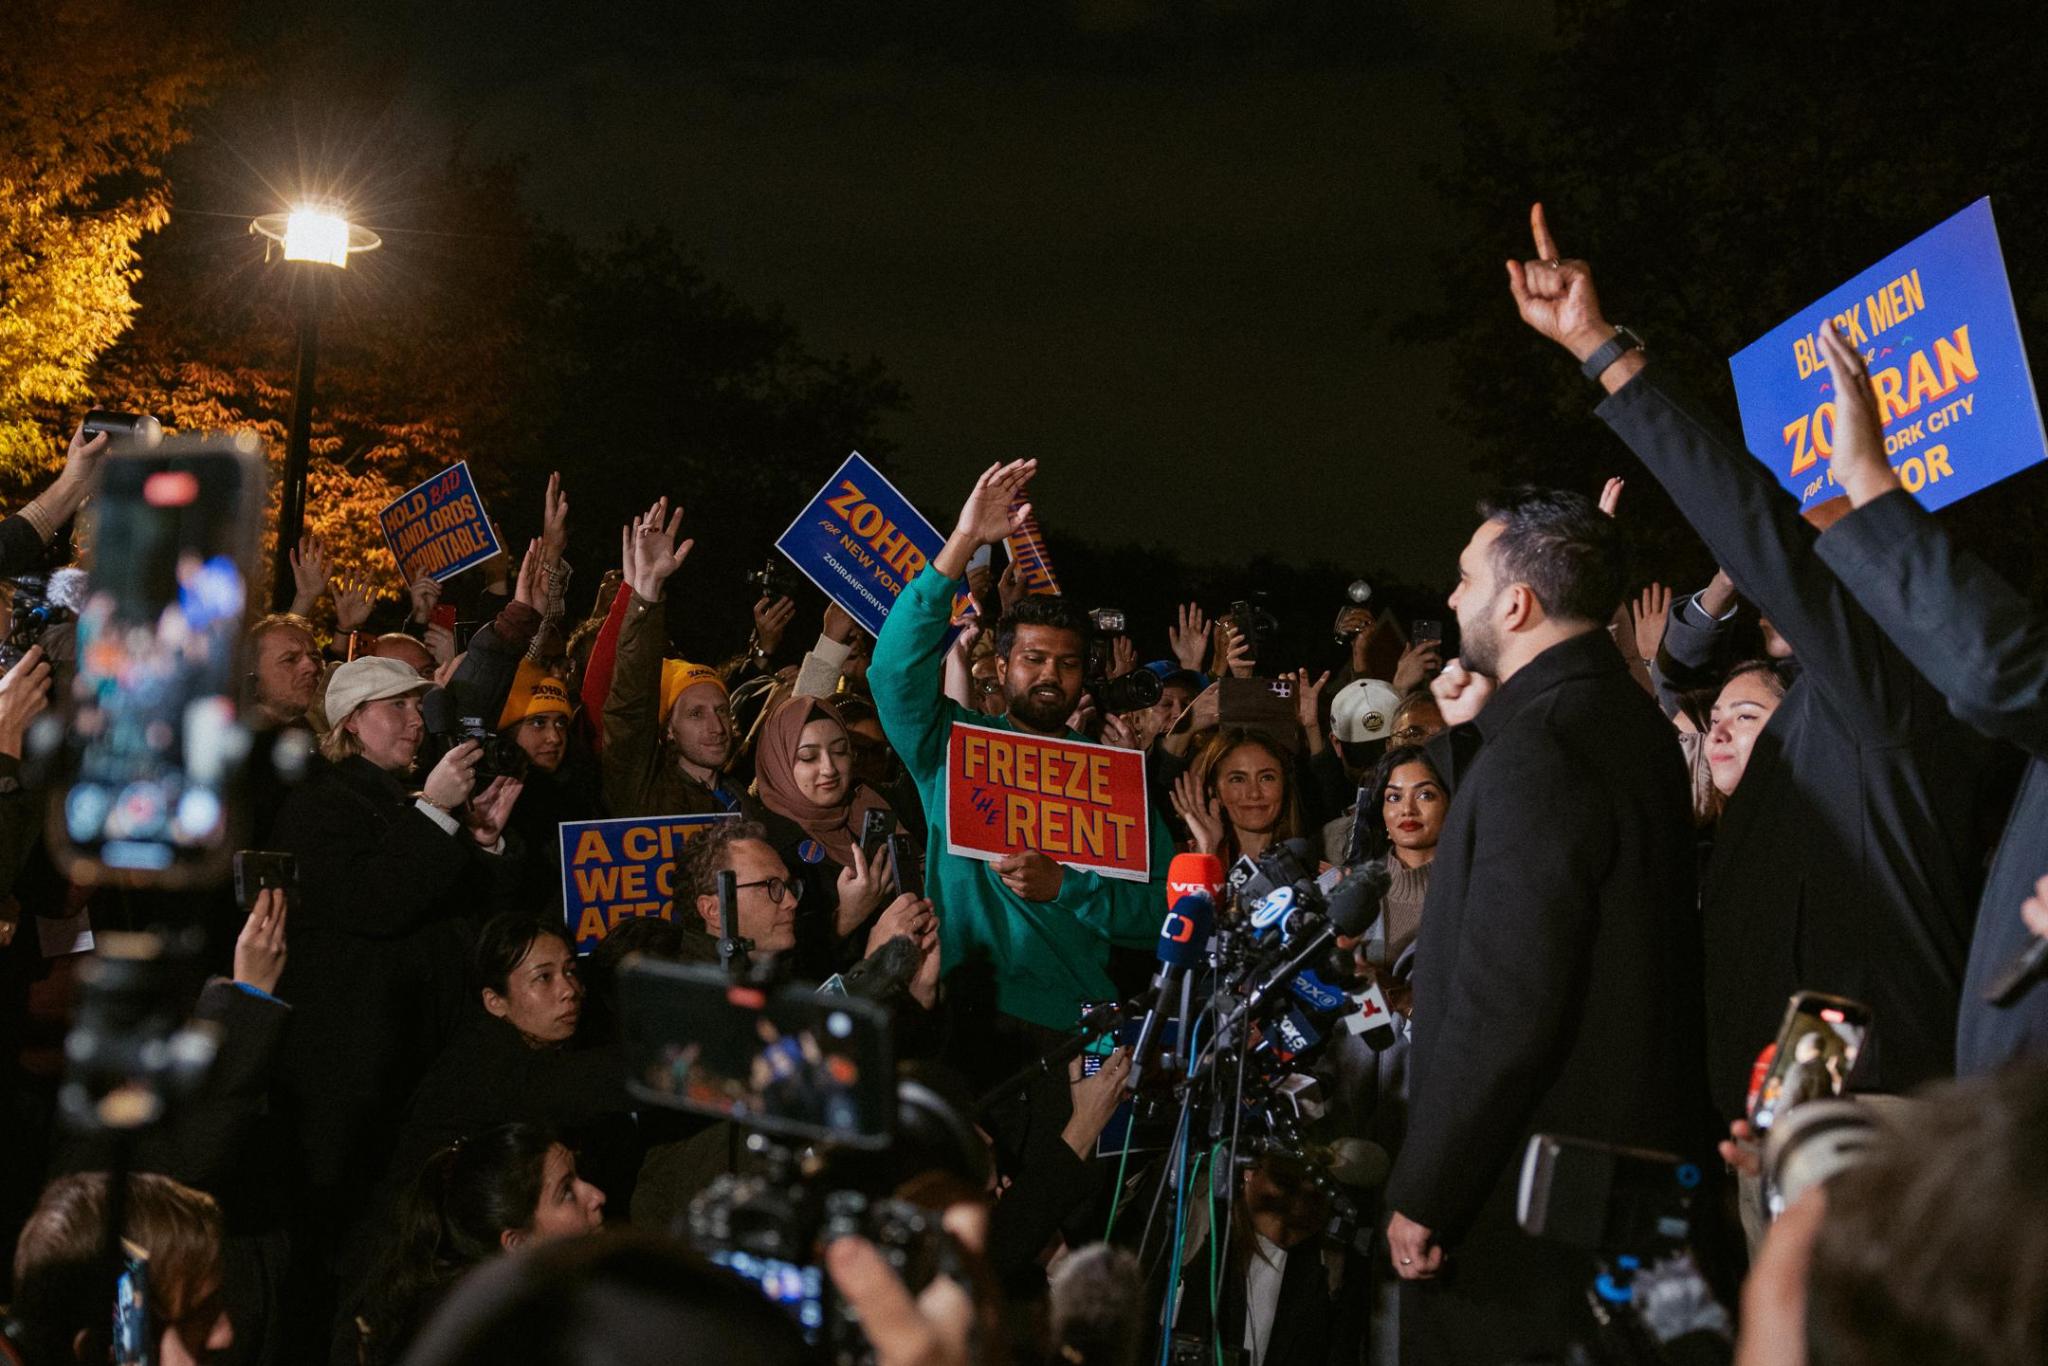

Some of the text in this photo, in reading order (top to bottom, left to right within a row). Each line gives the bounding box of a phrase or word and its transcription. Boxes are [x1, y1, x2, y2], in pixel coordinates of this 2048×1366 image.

[1793, 268, 1925, 380] BLCK MEN
[1783, 324, 1979, 476] ZORAN
[1802, 475, 1823, 503] FOR
[1884, 419, 1925, 456] ORK
[1927, 394, 1974, 433] CITY
[384, 470, 460, 533] HOLD BAD
[391, 494, 478, 560] LANDLORDS
[817, 519, 901, 597] FOR NEW YOR
[822, 552, 889, 617] ZOHRANFORNYC
[963, 735, 1113, 807] FREEZE
[572, 823, 713, 865] A CIT
[970, 787, 1136, 860] THE RENT
[573, 865, 648, 903] WE
[1171, 882, 1205, 894] VG
